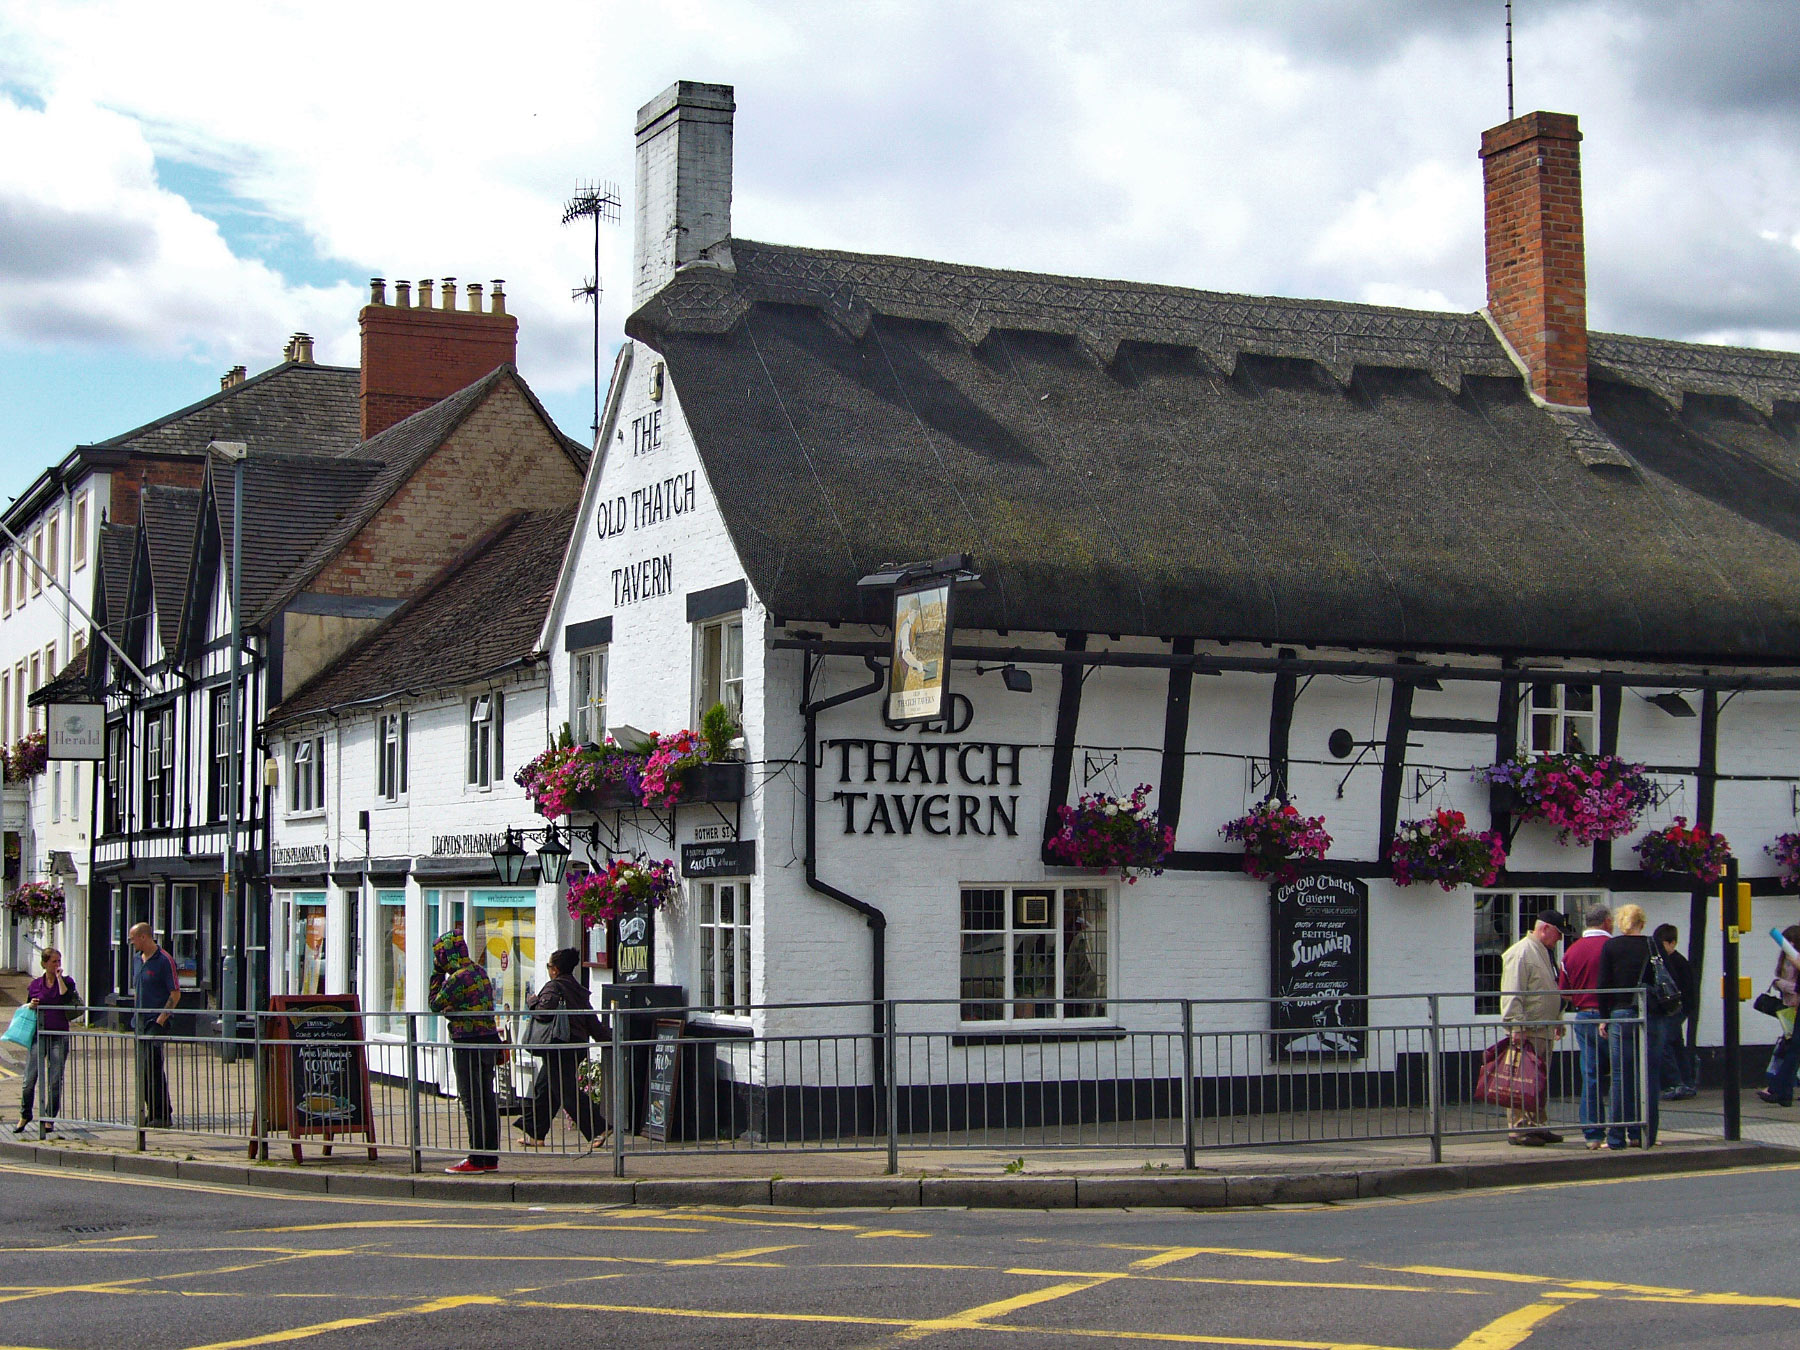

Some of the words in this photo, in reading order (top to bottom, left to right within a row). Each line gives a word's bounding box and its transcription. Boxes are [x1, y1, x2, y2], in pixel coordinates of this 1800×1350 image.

[632, 409, 662, 457] THE
[597, 496, 627, 540] OLD
[632, 470, 696, 531] THATCH
[611, 553, 672, 609] TAVERN
[54, 730, 100, 745] Herald
[828, 740, 1022, 786] THATCH
[833, 792, 1020, 837] TAVERN
[694, 827, 719, 840] ROTHER
[1278, 883, 1296, 902] The
[1296, 876, 1315, 890] Old
[1317, 875, 1355, 895] Thatch
[1297, 890, 1336, 906] Tavern
[1301, 930, 1338, 939] BRITISH
[618, 942, 648, 972] CARVERY
[1291, 934, 1352, 968] SUMMER
[305, 1060, 346, 1072] COTTAGE
[313, 1072, 335, 1084] PIE
